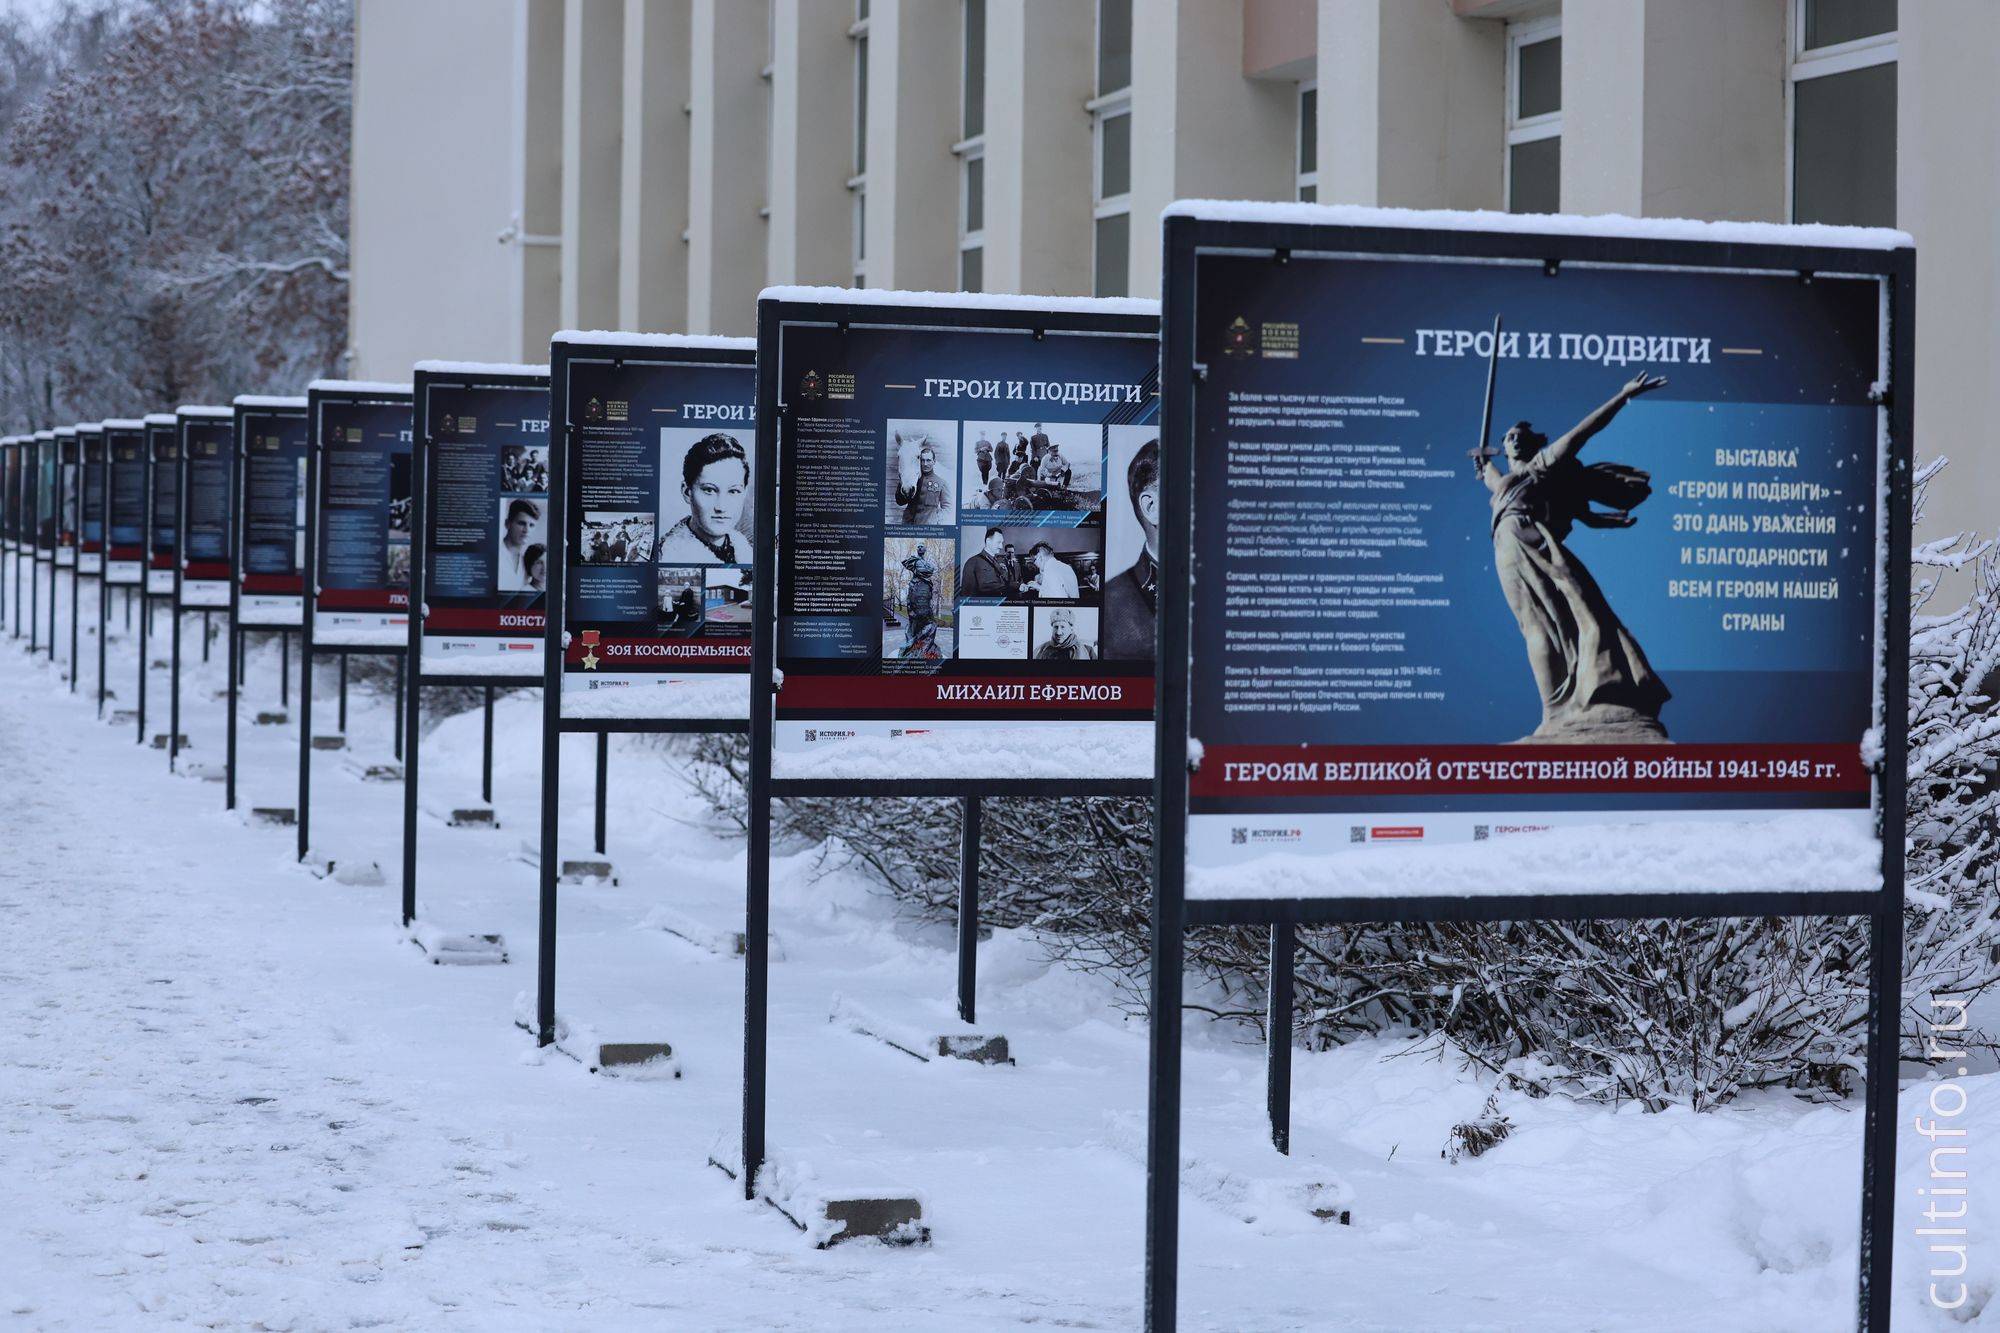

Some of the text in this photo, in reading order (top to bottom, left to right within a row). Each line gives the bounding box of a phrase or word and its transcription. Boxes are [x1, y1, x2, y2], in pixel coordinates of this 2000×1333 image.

[1416, 330, 1711, 366] ГЕРОИ И ПОДВИГИ
[924, 378, 1142, 405] ГЕРОИ И ПОДВИГИ
[683, 404, 744, 420] ГЕРОИ
[521, 420, 550, 432] ГЕР
[1716, 448, 1798, 468] ВЫСТАВКА
[1668, 481, 1728, 499] «ГЕРОИ
[1732, 482, 1742, 500] И
[1748, 483, 1830, 502] ПОДВИГИ»
[1672, 514, 1836, 534] ЭТО ДАНЬ УВАЖЕНИЯ
[1226, 547, 1258, 558] Маршал
[1259, 547, 1300, 557] Советского
[1302, 548, 1326, 557] Союза
[1327, 548, 1356, 559] Георгий
[1681, 548, 1828, 568] И БЛАГОДАРНОСТИ
[1668, 578, 1839, 600] ВСЕМ ГЕРОЯМ НАШЕЙ
[1722, 614, 1784, 631] СТРАНЫ
[606, 645, 632, 656] ЗОЯ
[936, 684, 1122, 701] МИХАИЛ ЕФРЕМОВ
[1224, 757, 1840, 782] ГЕРОЯМ ВЕЛИКОЙ ОТЕЧЕСТВЕННОЙ ВОЙНЫ 1941-1945 гг.
